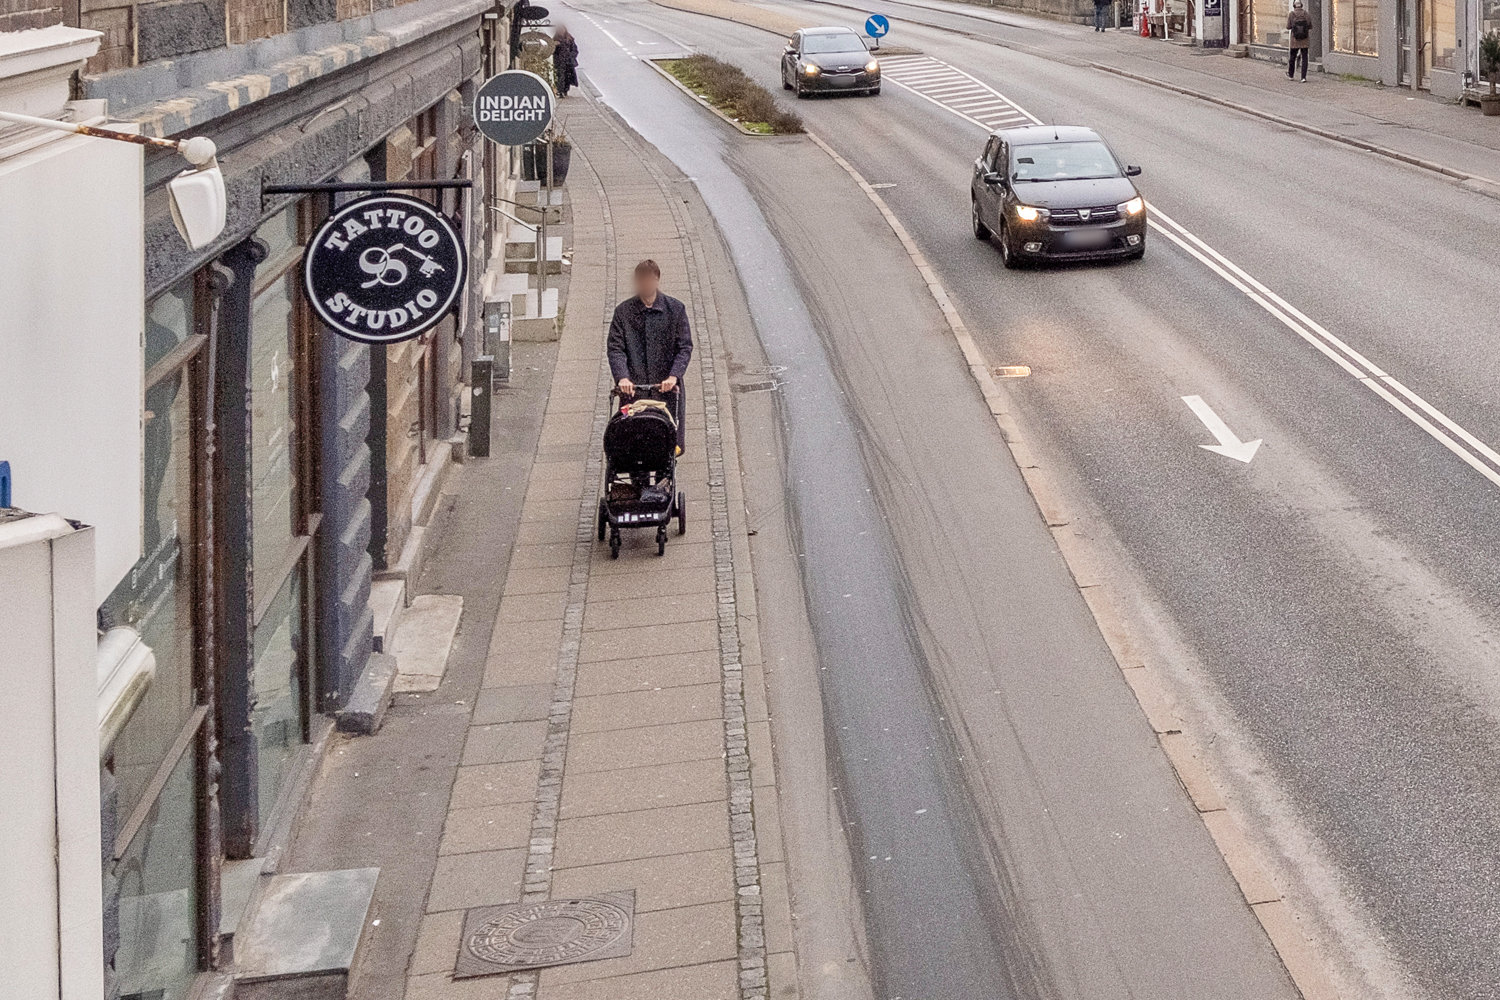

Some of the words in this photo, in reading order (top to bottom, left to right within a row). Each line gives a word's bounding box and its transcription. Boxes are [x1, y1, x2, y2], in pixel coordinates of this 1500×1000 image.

[480, 95, 546, 110] INDIAN
[480, 109, 545, 122] DELIGHT
[324, 209, 440, 251] TATTOO
[325, 289, 438, 329] STUDIO
